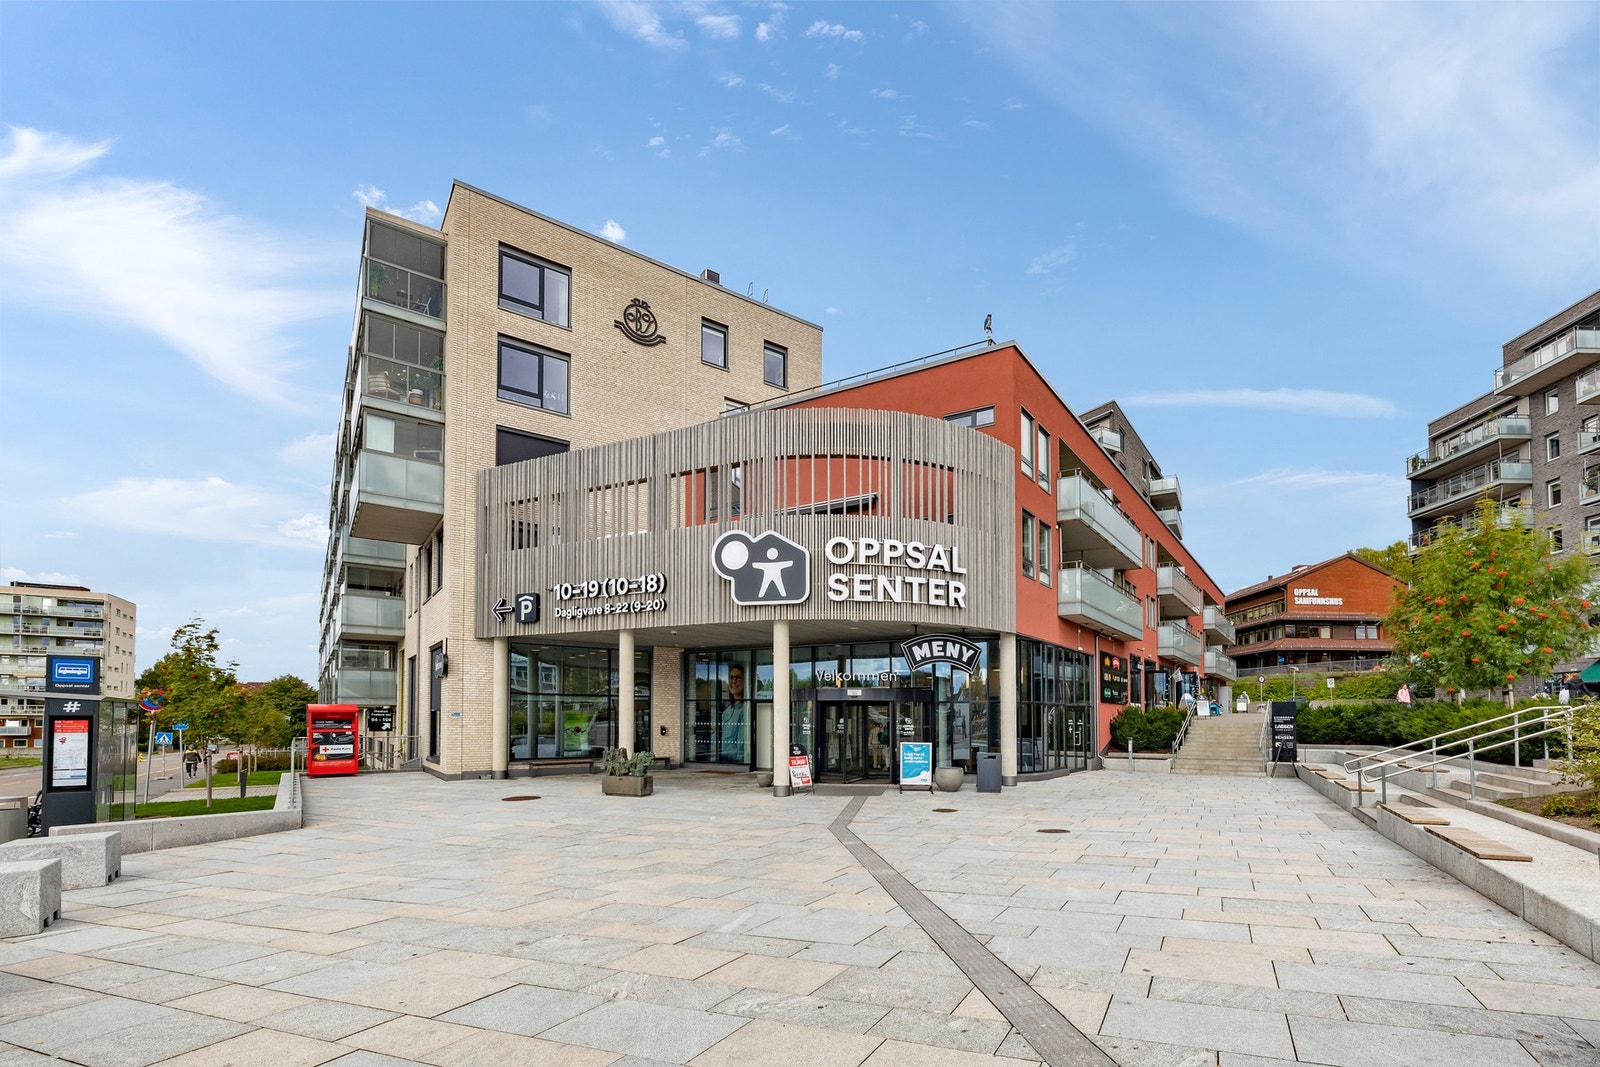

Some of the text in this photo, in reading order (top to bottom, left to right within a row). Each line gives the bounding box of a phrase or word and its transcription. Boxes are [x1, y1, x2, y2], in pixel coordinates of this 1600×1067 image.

[825, 536, 967, 574] OPPSAL
[827, 573, 966, 608] SENTER
[1293, 588, 1319, 596] OPPSAL
[1294, 597, 1343, 605] SAMFUNNSHUS
[554, 606, 602, 619] Dagligvare
[911, 641, 975, 662] MENY
[815, 669, 897, 682] Velkommen
